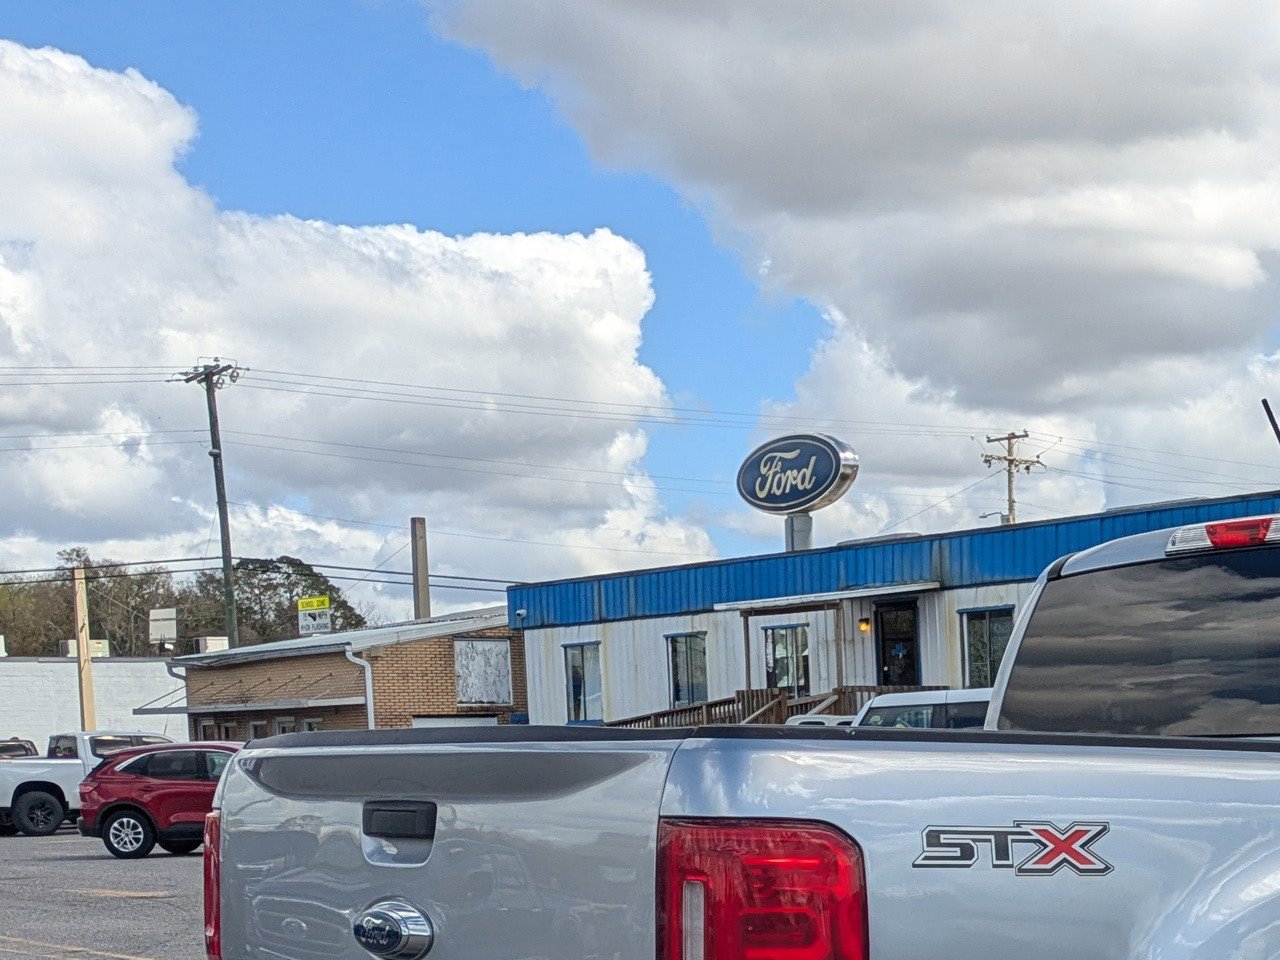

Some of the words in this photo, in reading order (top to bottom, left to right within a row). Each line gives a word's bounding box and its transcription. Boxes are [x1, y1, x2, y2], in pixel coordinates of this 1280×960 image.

[755, 449, 817, 499] Ford
[911, 820, 1115, 876] STX
[359, 916, 390, 945] Ford
